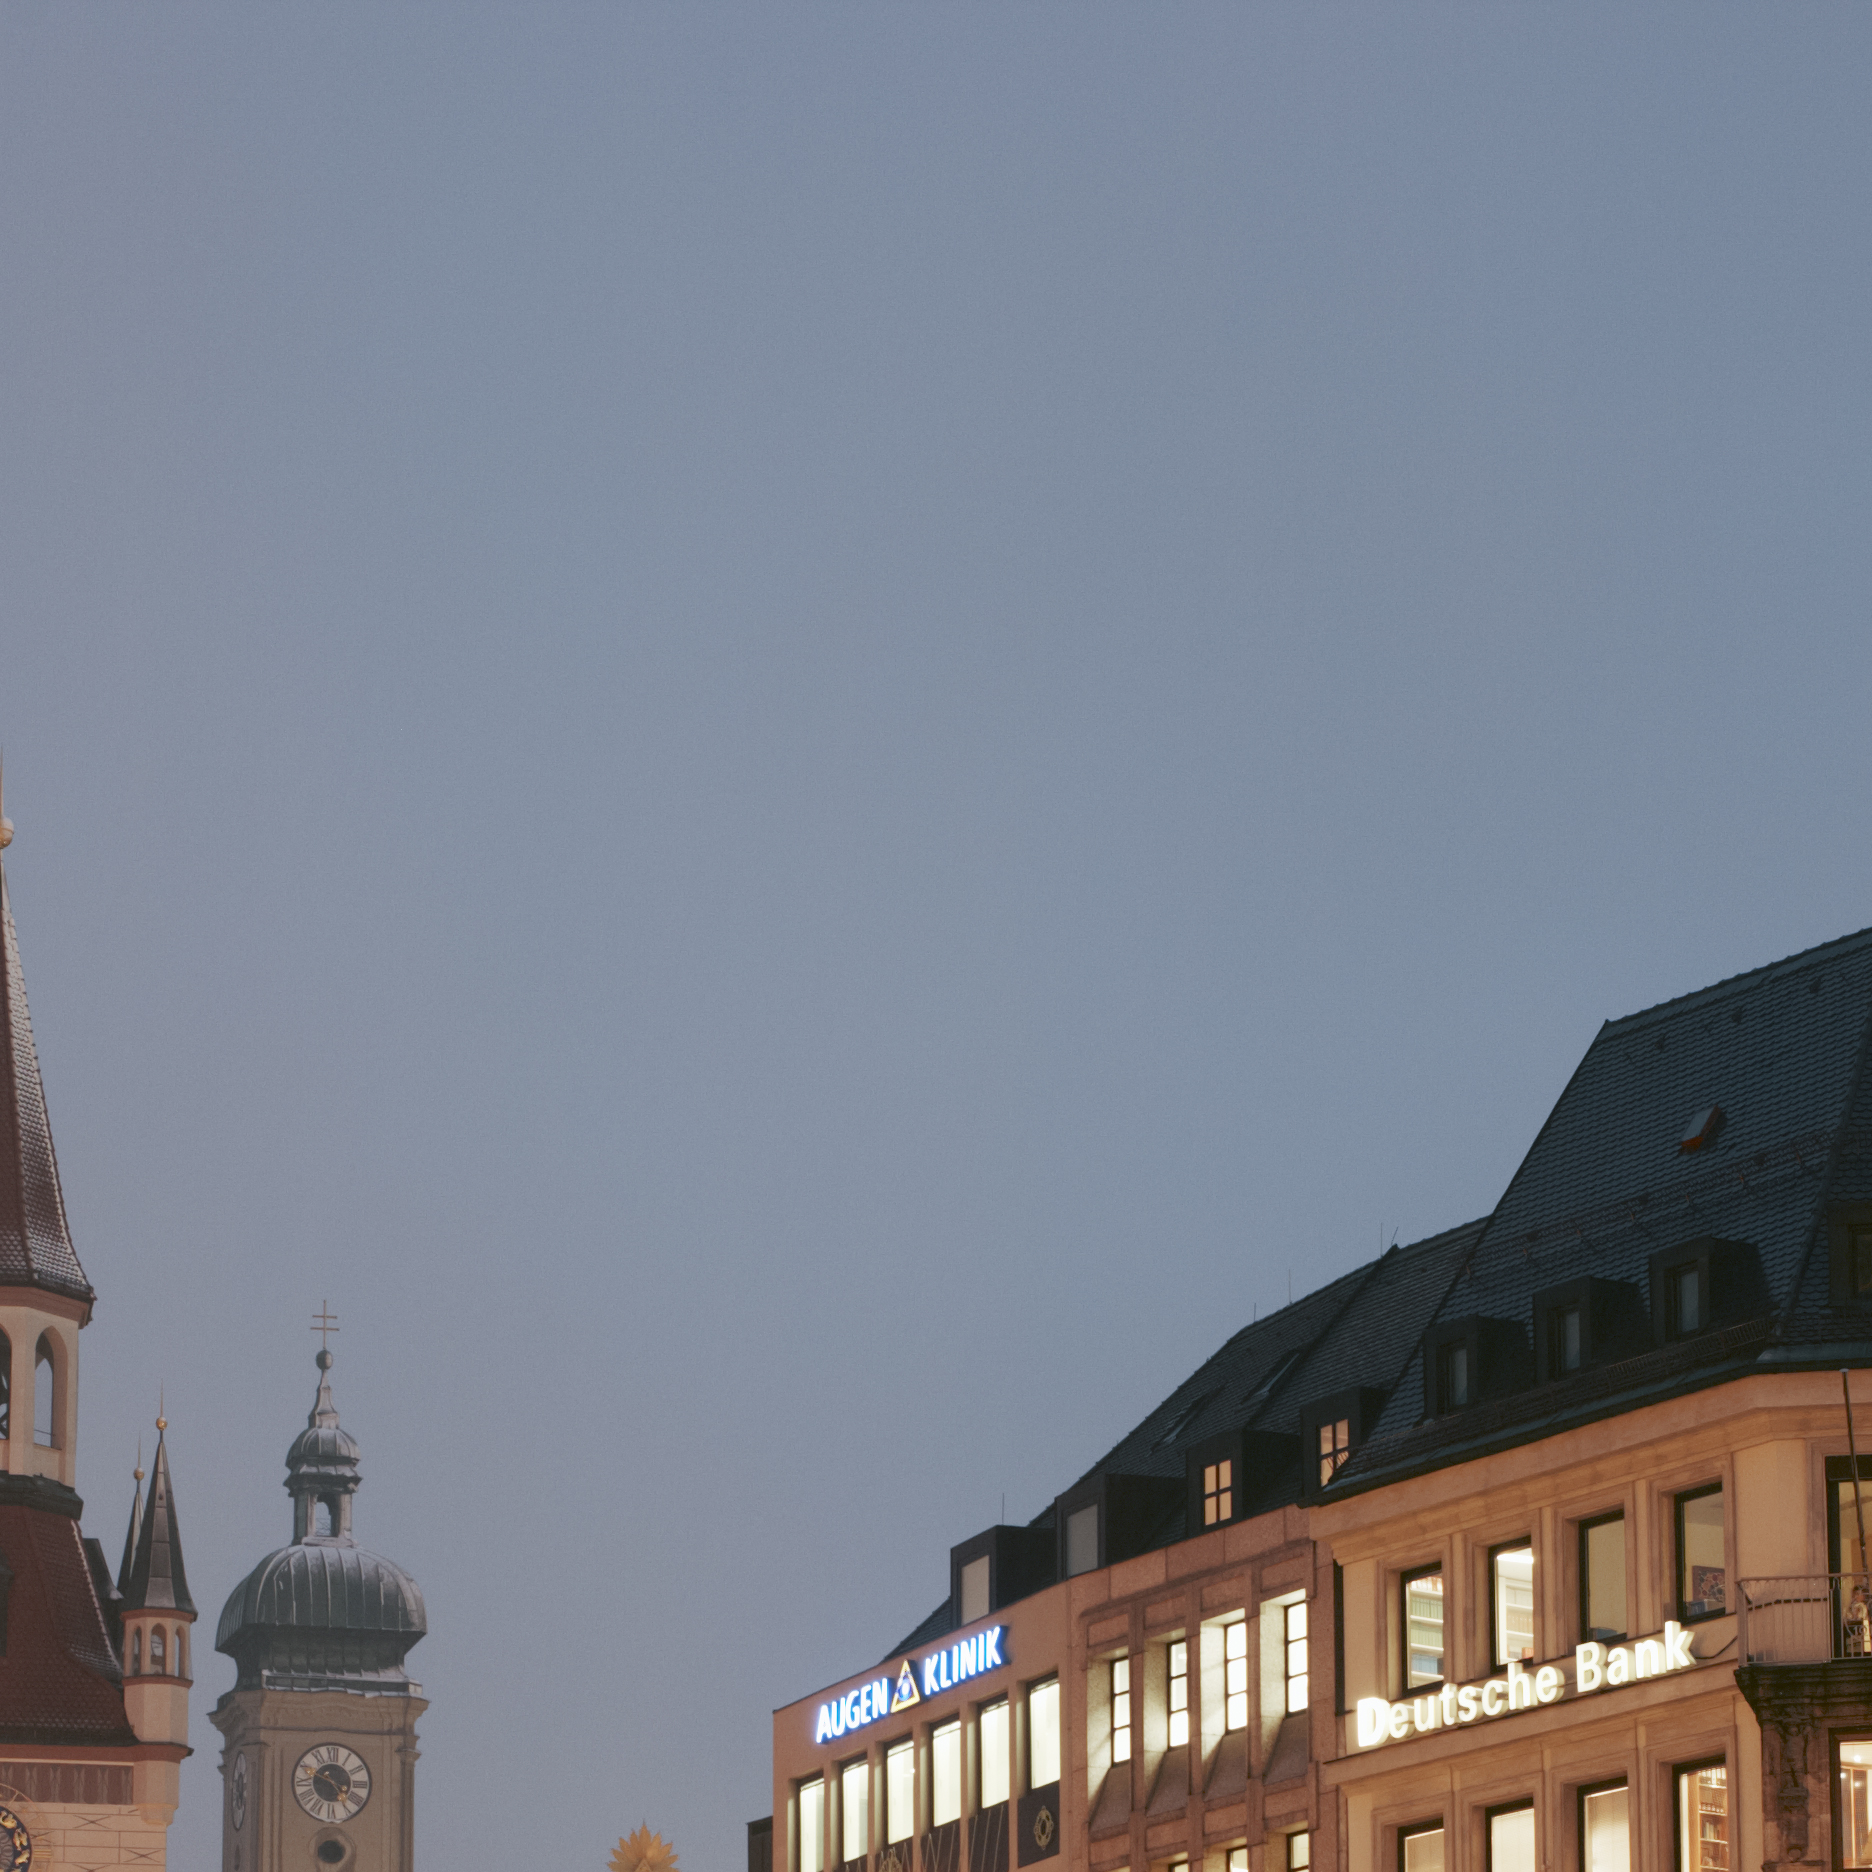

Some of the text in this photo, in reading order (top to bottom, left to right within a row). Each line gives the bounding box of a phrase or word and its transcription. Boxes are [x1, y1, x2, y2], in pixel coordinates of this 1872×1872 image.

[815, 1625, 1005, 1744] AUGEN KLINIK
[1357, 1620, 1697, 1748] Deutsche Bank
